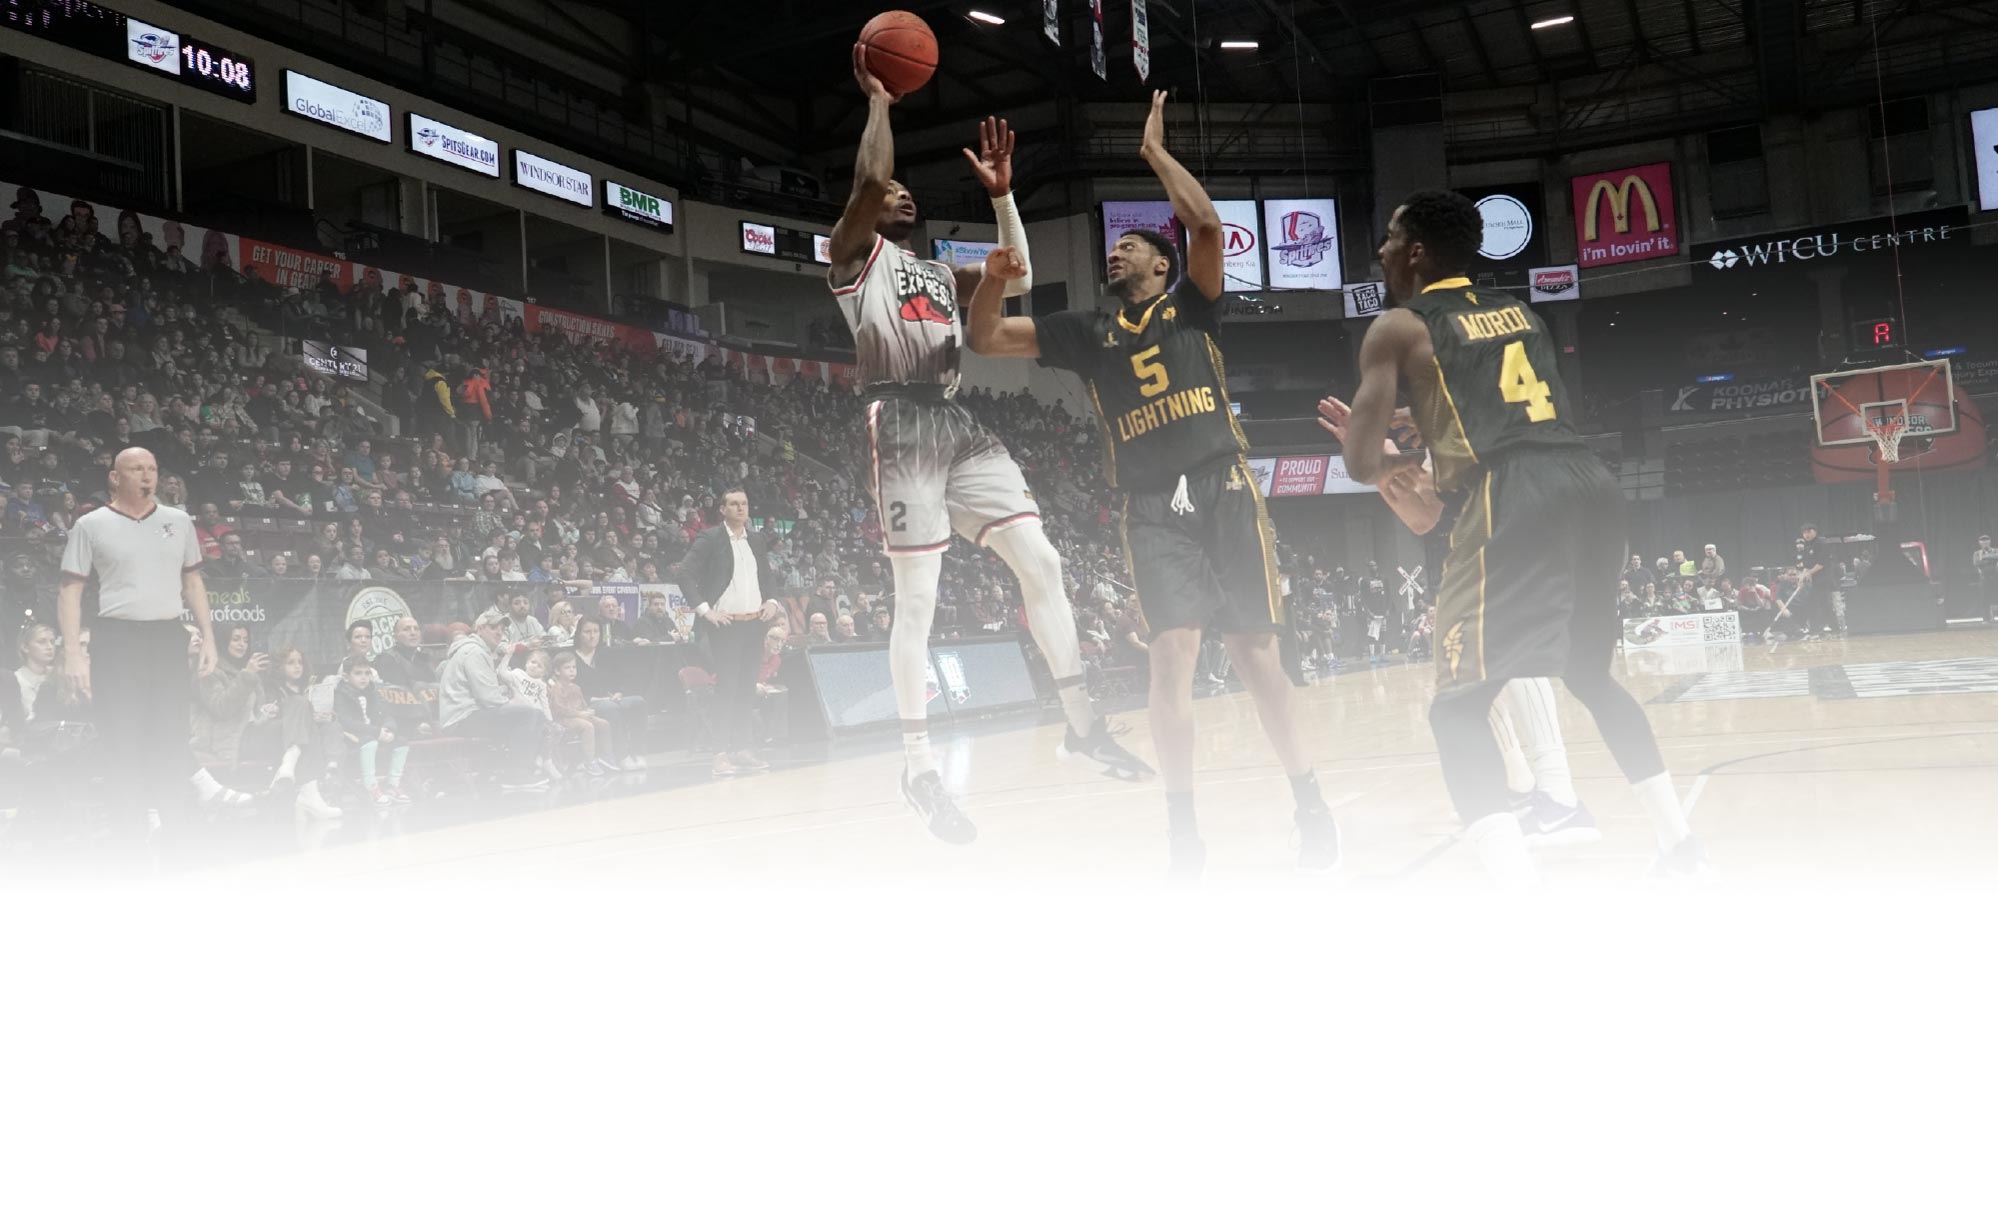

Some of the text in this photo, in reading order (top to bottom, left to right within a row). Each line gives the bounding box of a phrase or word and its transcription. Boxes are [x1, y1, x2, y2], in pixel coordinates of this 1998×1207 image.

[182, 45, 250, 90] 10:08
[520, 161, 588, 195] WINDSOR STAR
[619, 187, 660, 216] BMR
[252, 245, 272, 264] GET
[274, 250, 302, 270] YOUR
[1279, 239, 1332, 267] Spitfires
[1582, 247, 1607, 261] i'm
[1610, 238, 1654, 257] lovin'
[1739, 225, 1951, 267] WFCU CENTRE
[275, 267, 288, 285] IN
[1457, 306, 1531, 340] MORDI
[1130, 344, 1170, 398] 5
[1499, 340, 1557, 423] 4
[1117, 386, 1215, 442] LIGHTNING
[1280, 460, 1321, 475] PROUD
[890, 501, 906, 531] 2
